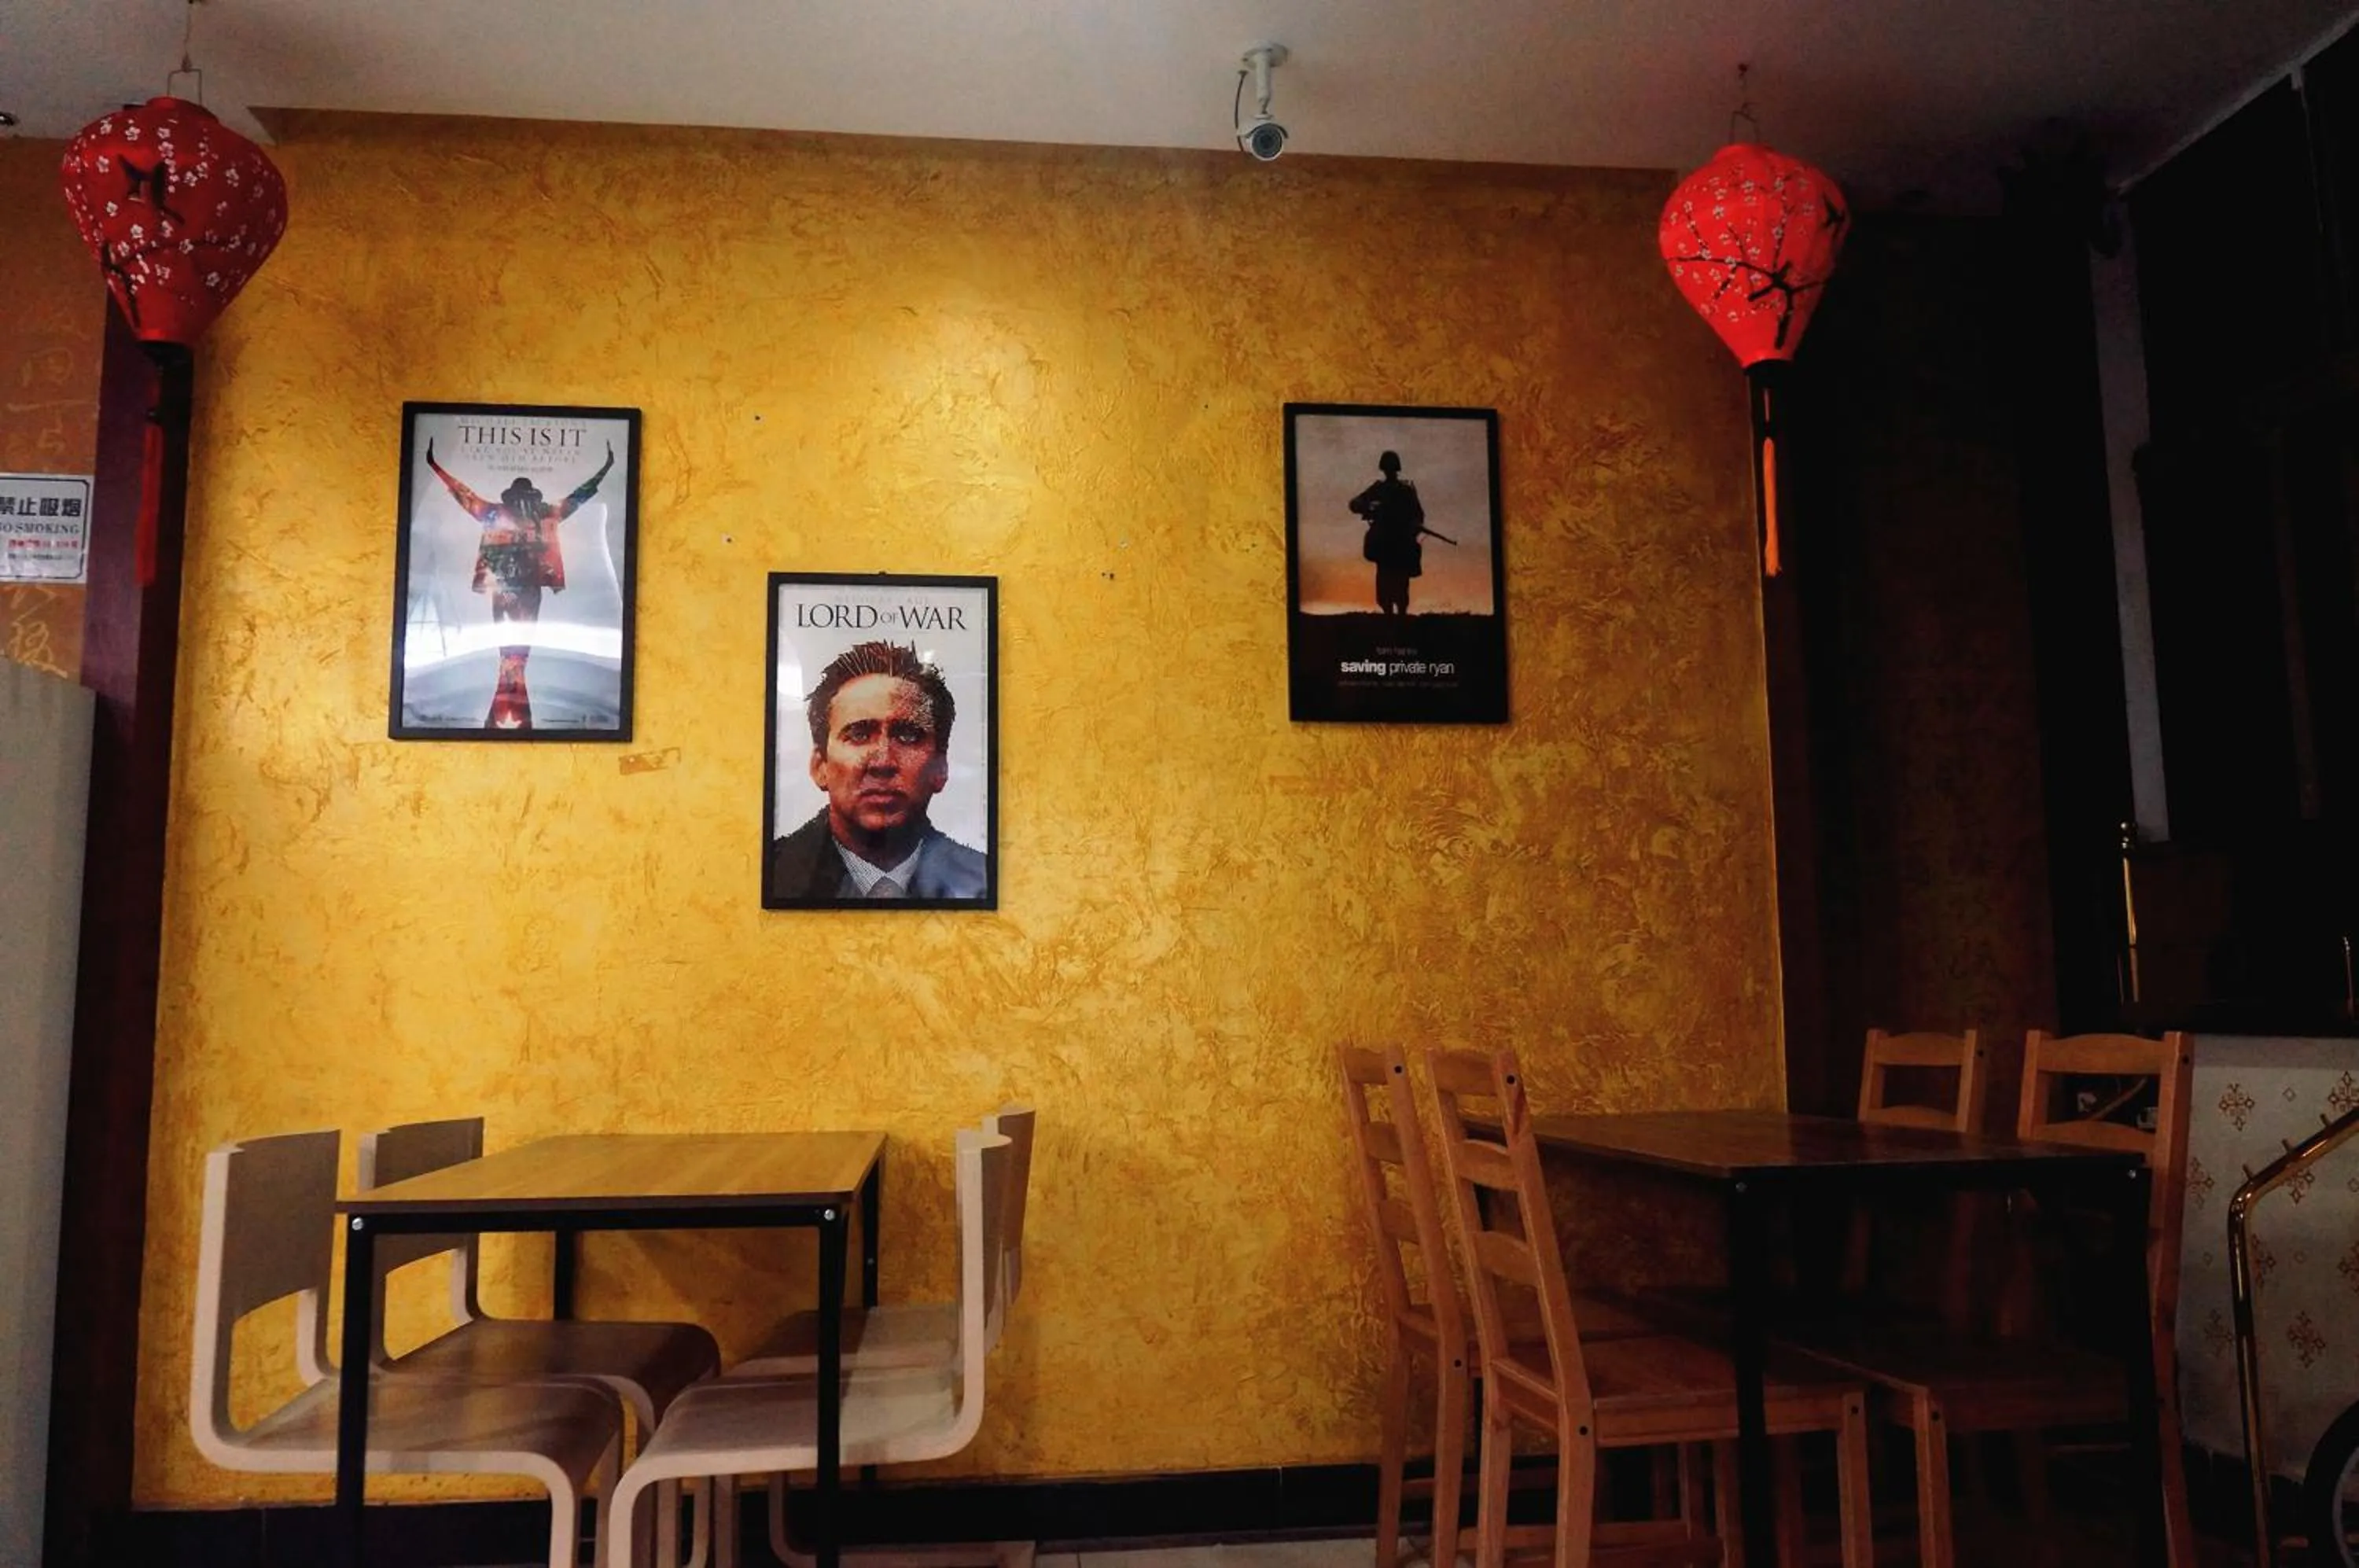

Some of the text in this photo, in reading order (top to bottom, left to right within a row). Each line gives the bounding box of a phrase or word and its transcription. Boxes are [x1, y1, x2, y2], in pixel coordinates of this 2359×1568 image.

[458, 425, 587, 447] THIS IS IT
[15, 523, 80, 534] SMOKING
[797, 603, 967, 630] LORD OF WAR
[1341, 659, 1455, 677] saving private ryan
